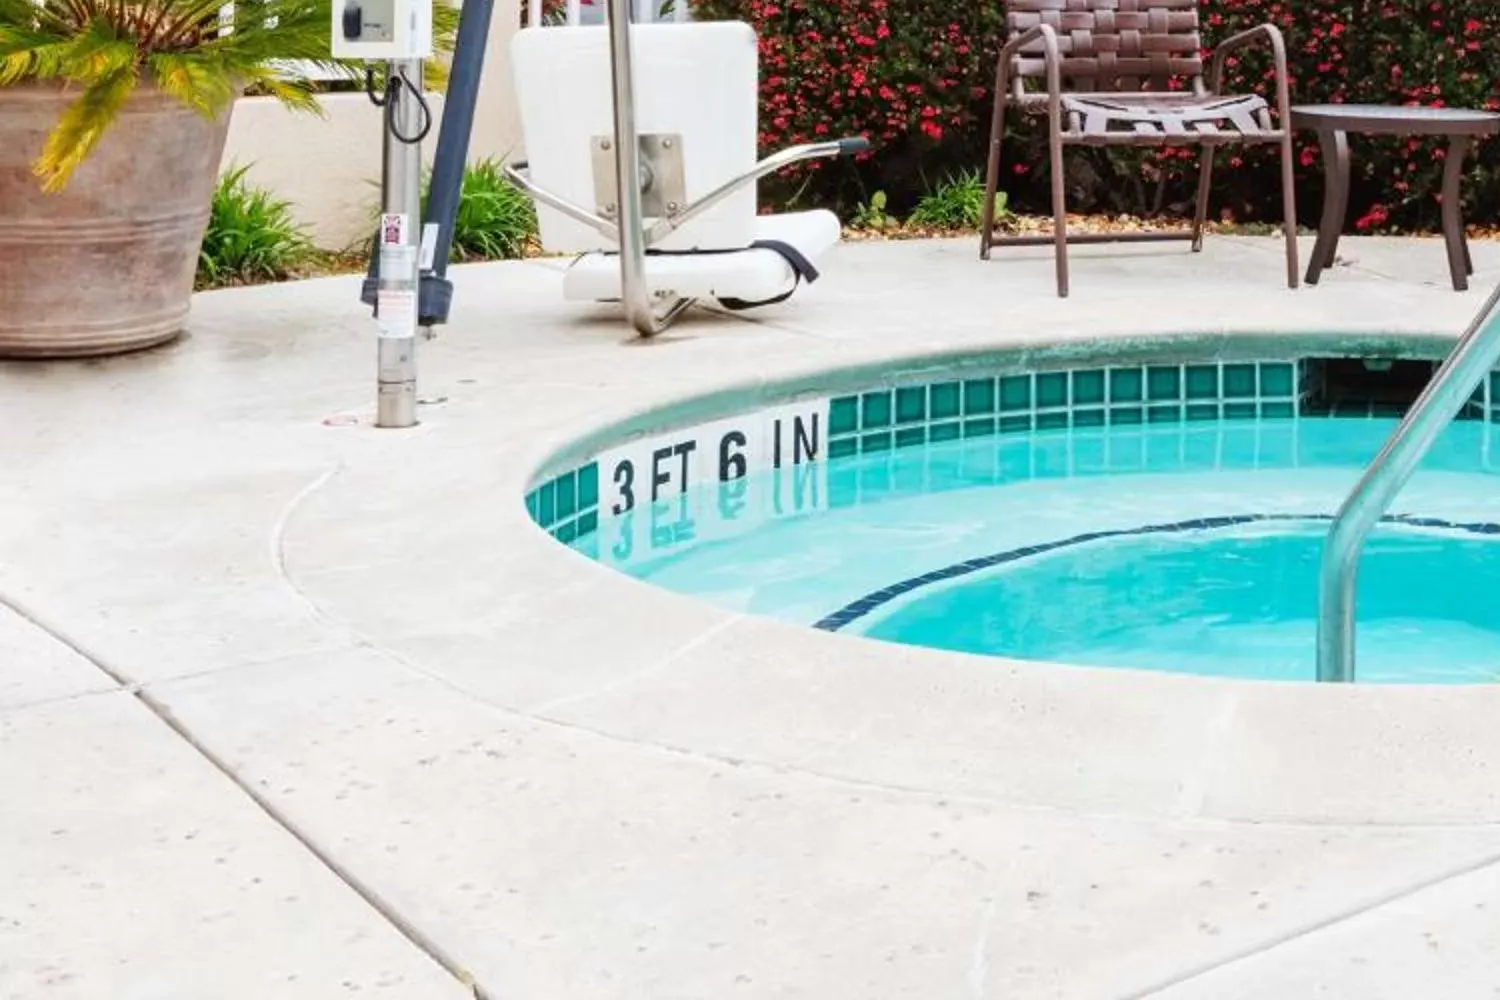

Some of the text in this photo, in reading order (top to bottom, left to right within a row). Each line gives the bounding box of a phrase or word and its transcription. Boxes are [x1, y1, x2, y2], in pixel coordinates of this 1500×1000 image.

[612, 413, 819, 516] 3 FT 6 IN
